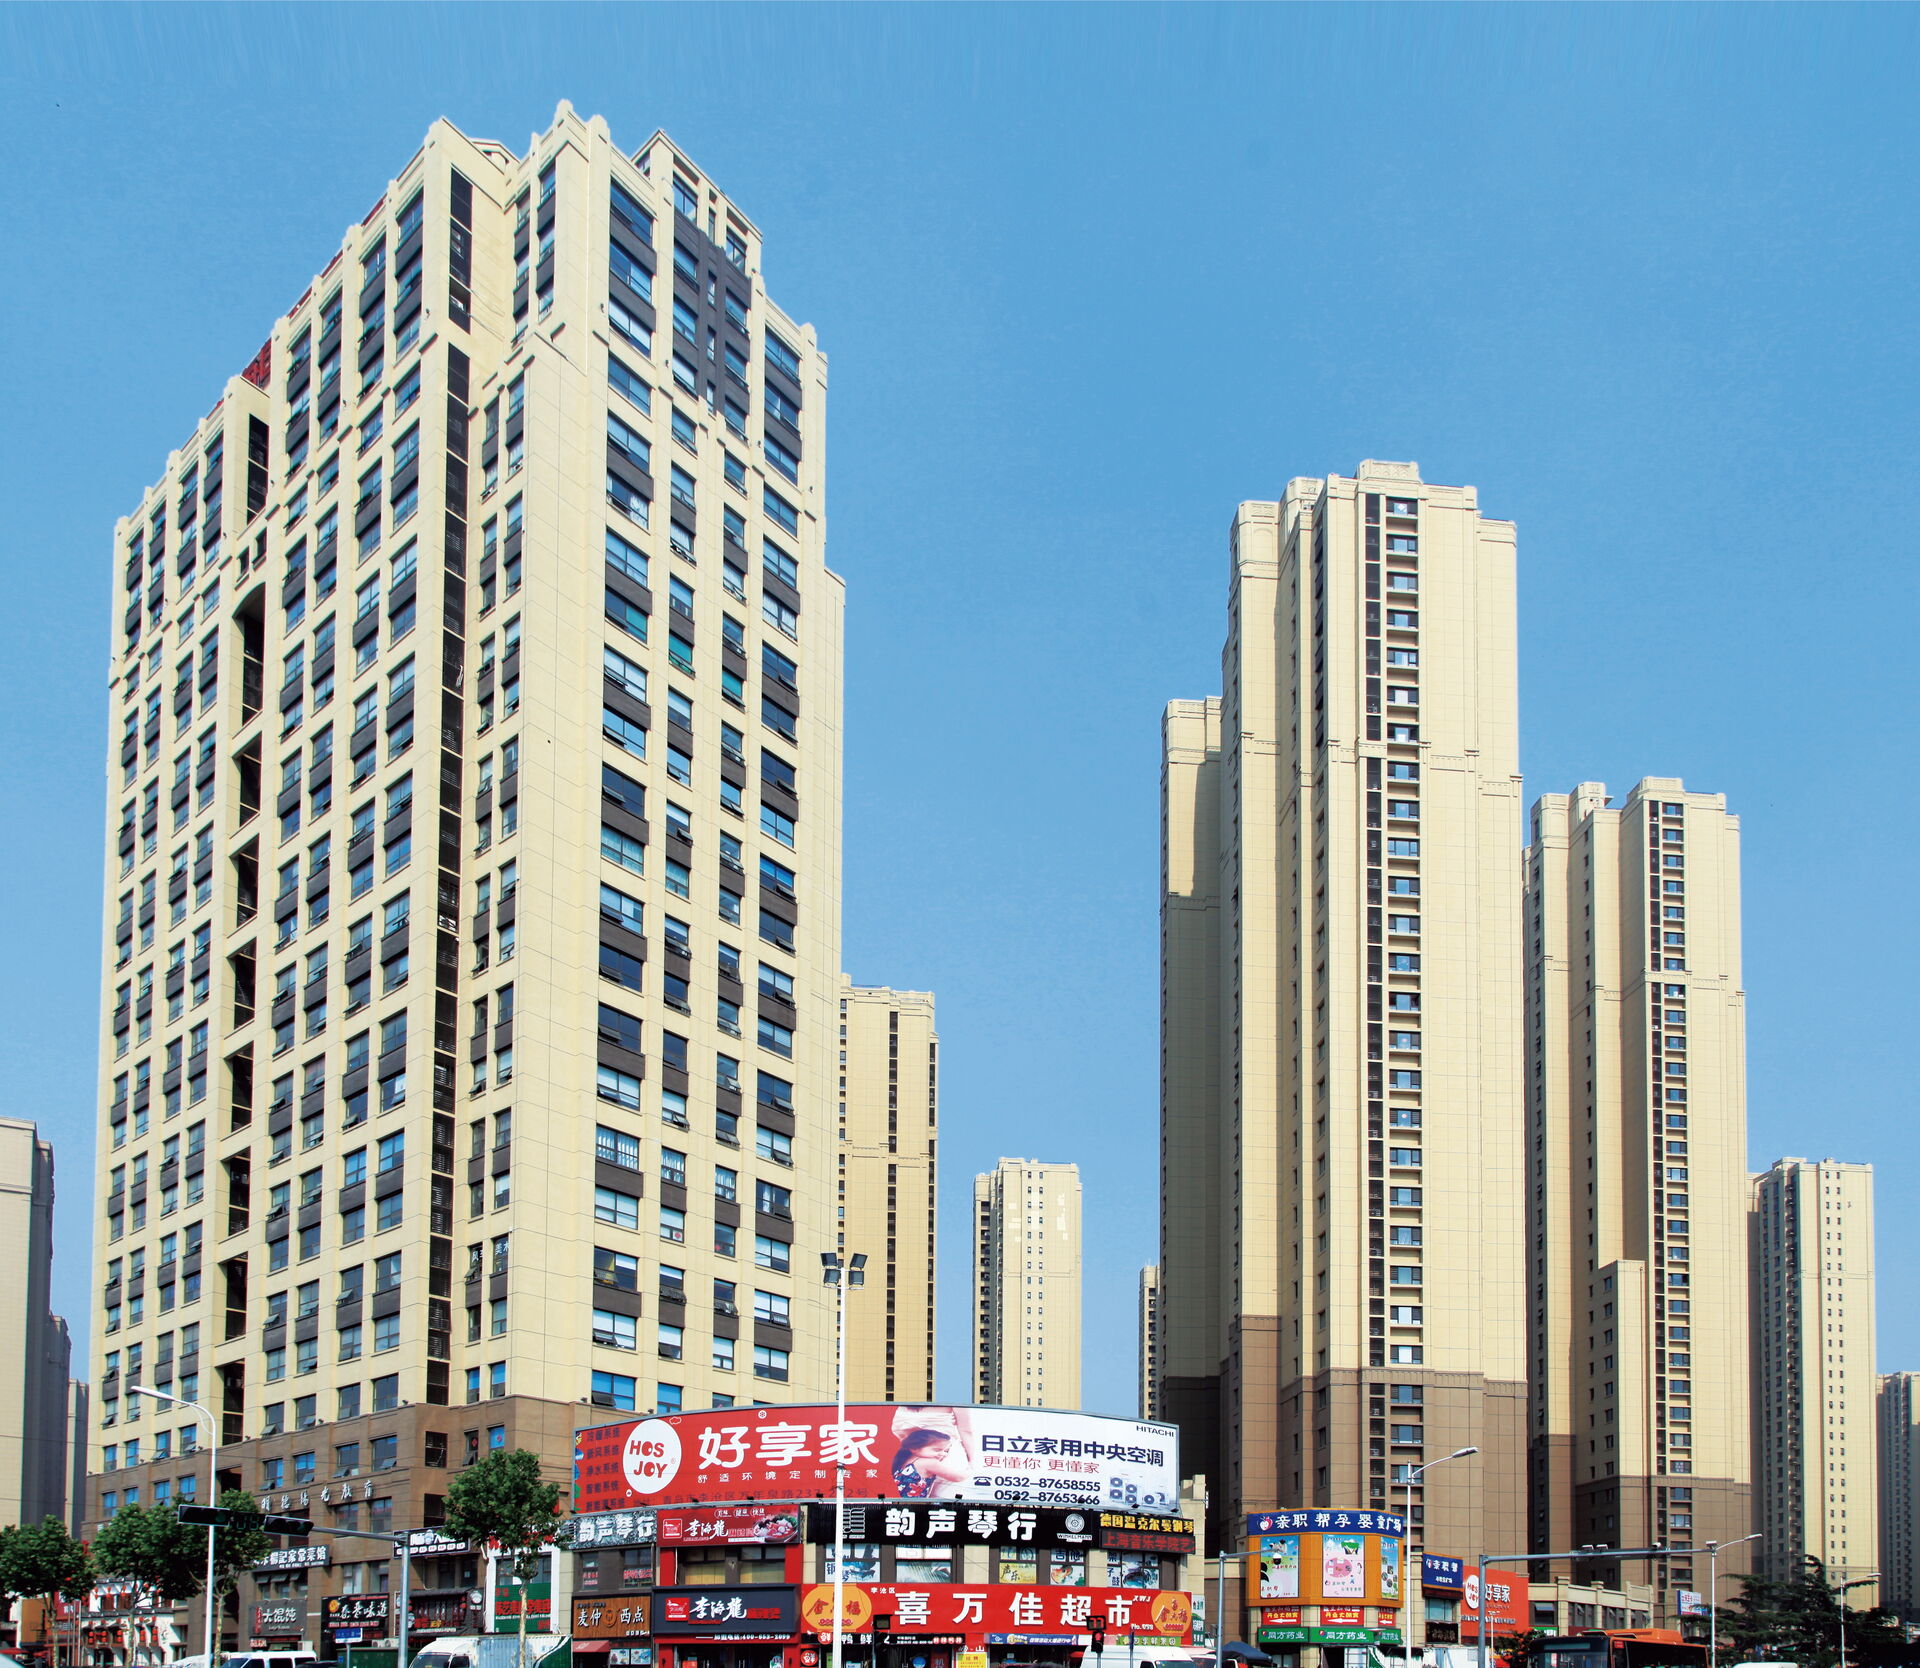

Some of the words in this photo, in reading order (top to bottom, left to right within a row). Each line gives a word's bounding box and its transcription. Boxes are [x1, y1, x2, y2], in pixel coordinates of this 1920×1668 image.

[1136, 1424, 1175, 1437] HITACHI
[629, 1440, 665, 1458] HOS
[698, 1421, 879, 1470] 好享家
[981, 1434, 1164, 1467] 日立家用中央空调
[633, 1460, 668, 1478] JOY
[983, 1455, 1042, 1470] 更懂你
[1048, 1458, 1100, 1475] 更懂家
[697, 1469, 878, 1484] 舒适环境定制专家
[994, 1475, 1101, 1492] 0532-87658555
[579, 1514, 655, 1543] 韵声琴行
[684, 1518, 729, 1540] 李海龍
[885, 1508, 1037, 1542] 韵声琴行
[1099, 1513, 1194, 1533] 德国温克尔曼钢琴
[1275, 1512, 1402, 1533] 亲职帮孕婴童广场
[1485, 1583, 1511, 1603] 好享家
[620, 1606, 644, 1624] 西点
[689, 1596, 748, 1622] 李海龍
[894, 1591, 1133, 1627] 喜万佳超市
[1088, 1616, 1105, 1629] 77
[1268, 1630, 1305, 1640] 同方药业
[1325, 1630, 1367, 1641] 同方药业
